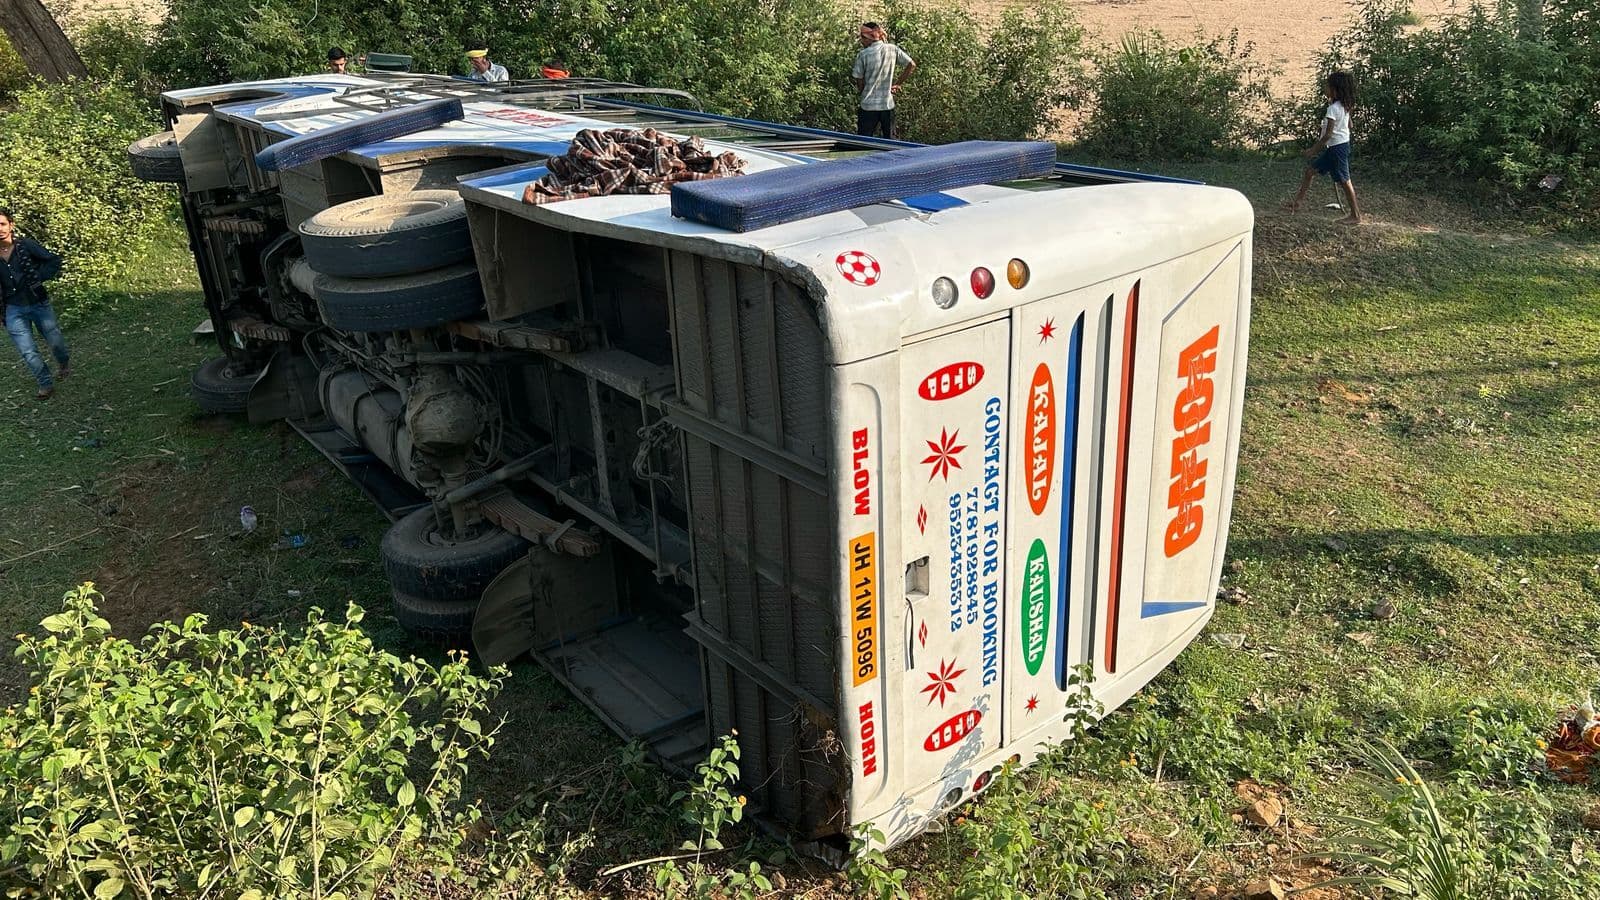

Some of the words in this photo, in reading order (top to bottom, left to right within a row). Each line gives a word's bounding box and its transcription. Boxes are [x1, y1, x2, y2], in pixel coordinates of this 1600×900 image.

[927, 365, 977, 398] STOP
[852, 427, 870, 516] BLOW
[984, 396, 1001, 513] CONTACT
[1032, 381, 1049, 501] KAJAL
[854, 542, 871, 571] JH
[949, 493, 963, 632] 9523435312
[966, 486, 979, 625] 7781928845
[983, 520, 999, 577] FOR
[855, 577, 872, 622] 11W
[983, 580, 998, 687] BOOKING
[1028, 554, 1045, 662] KAUSHAL
[857, 627, 874, 678] 5096
[858, 701, 877, 777] HORN
[931, 712, 975, 749] STOP
